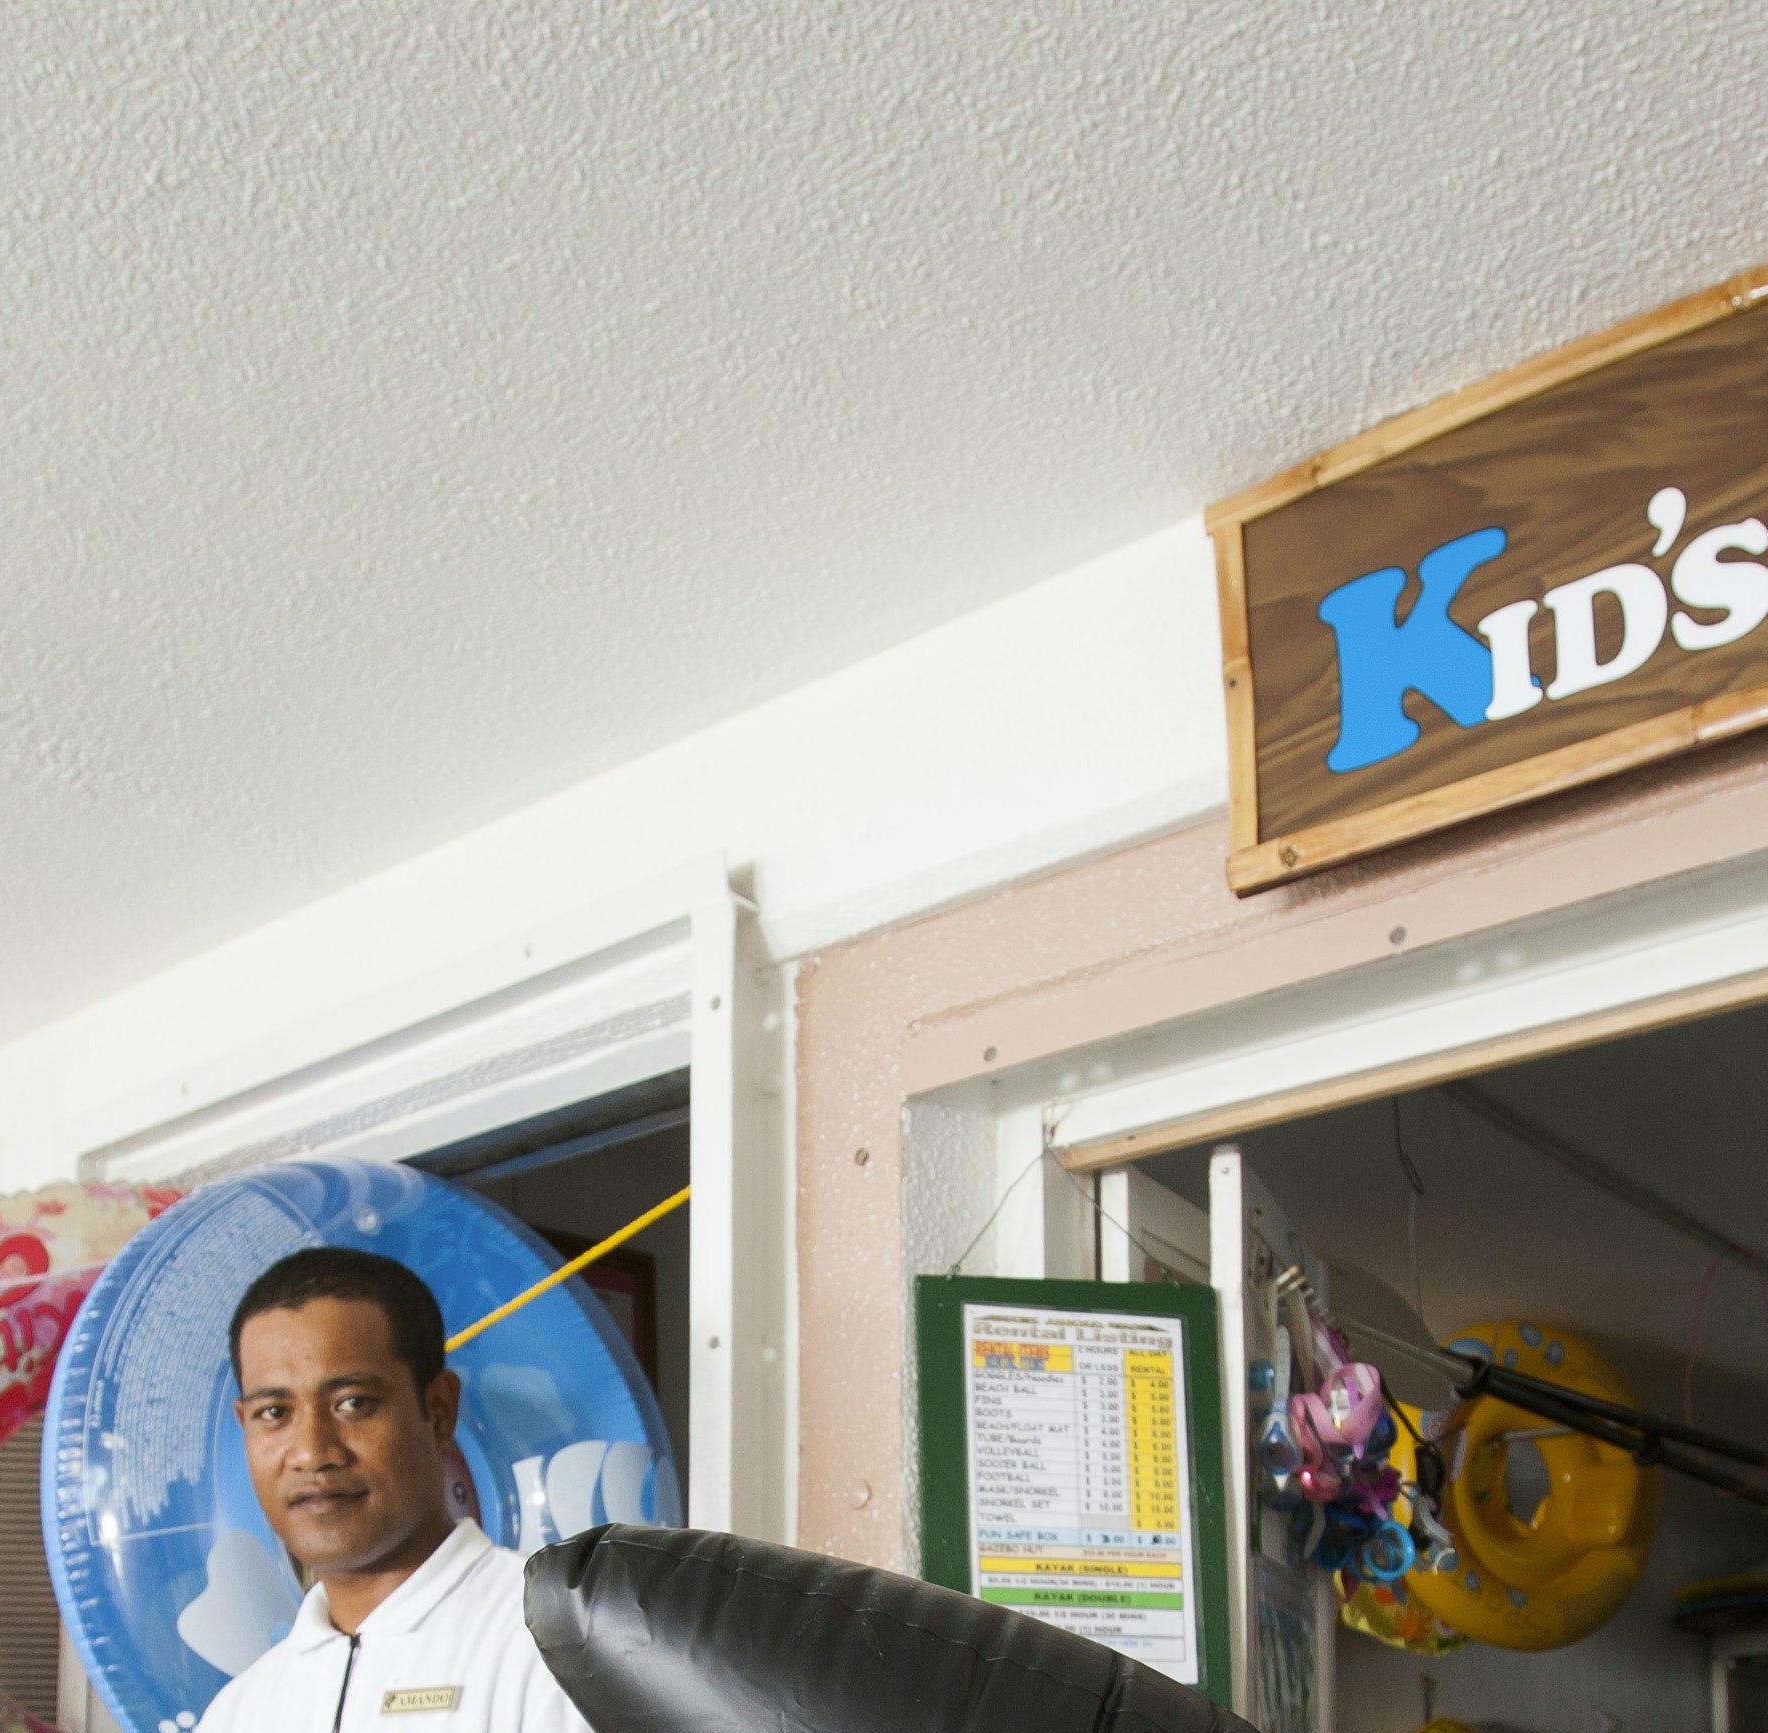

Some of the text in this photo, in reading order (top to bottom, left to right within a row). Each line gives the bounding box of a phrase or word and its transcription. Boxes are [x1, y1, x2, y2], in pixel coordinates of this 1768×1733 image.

[973, 1320, 1066, 1340] Rental
[1076, 1326, 1173, 1349] Listing
[1085, 1345, 1119, 1355] HOURS
[1095, 1362, 1119, 1372] LESS
[1130, 1365, 1166, 1375] RENTAL
[975, 1382, 1009, 1393] BEACH
[1014, 1384, 1039, 1395] BALL
[976, 1407, 1013, 1418] BOOTS
[978, 1459, 1018, 1469] SOCCER
[1022, 1460, 1047, 1471] BALL
[977, 1471, 1031, 1483] FOOTBALL
[979, 1511, 1017, 1523] TOWEL
[1035, 1563, 1129, 1575] KAYAK (SINGLE)
[1034, 1592, 1132, 1605] KAYAK (DOUBLE)
[1070, 1611, 1098, 1620] HOUR
[1094, 1625, 1122, 1634] HOUR
